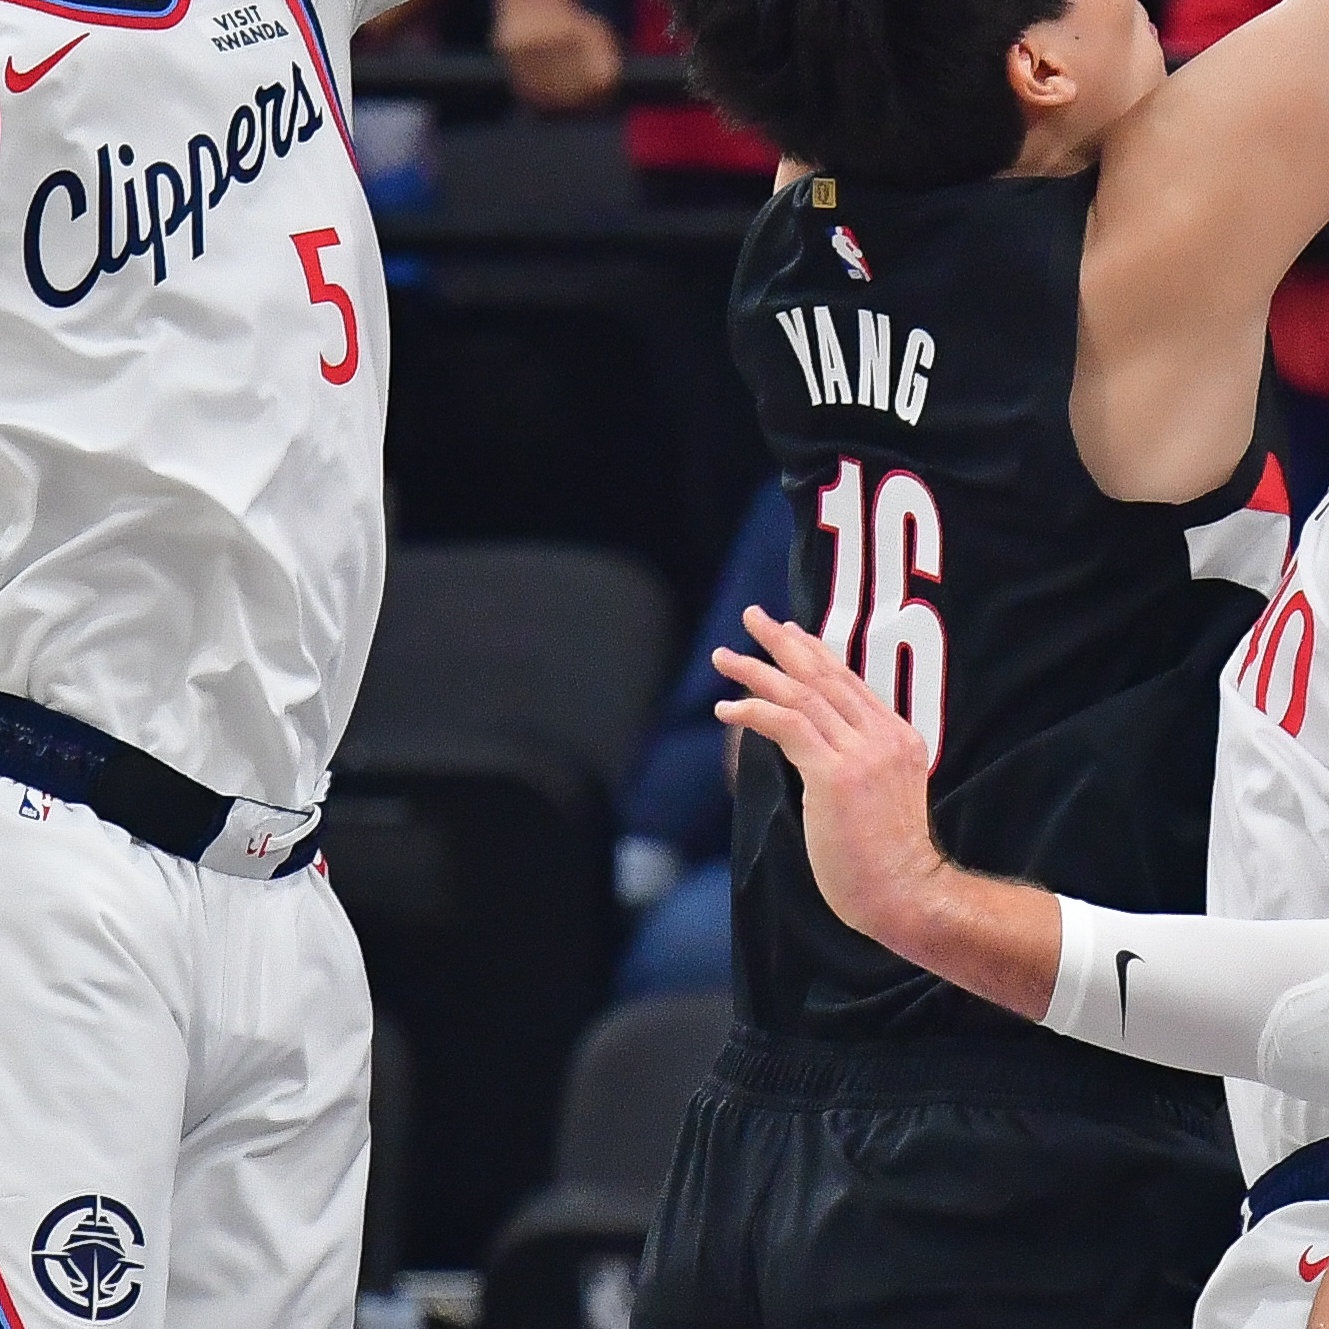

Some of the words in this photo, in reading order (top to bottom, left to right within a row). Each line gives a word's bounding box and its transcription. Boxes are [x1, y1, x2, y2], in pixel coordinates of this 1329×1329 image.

[211, 20, 289, 52] RWANDA
[212, 5, 262, 31] VISIT
[23, 61, 323, 309] Clippers
[289, 227, 359, 386] 5
[776, 305, 935, 425] YANG
[817, 454, 947, 776] 16
